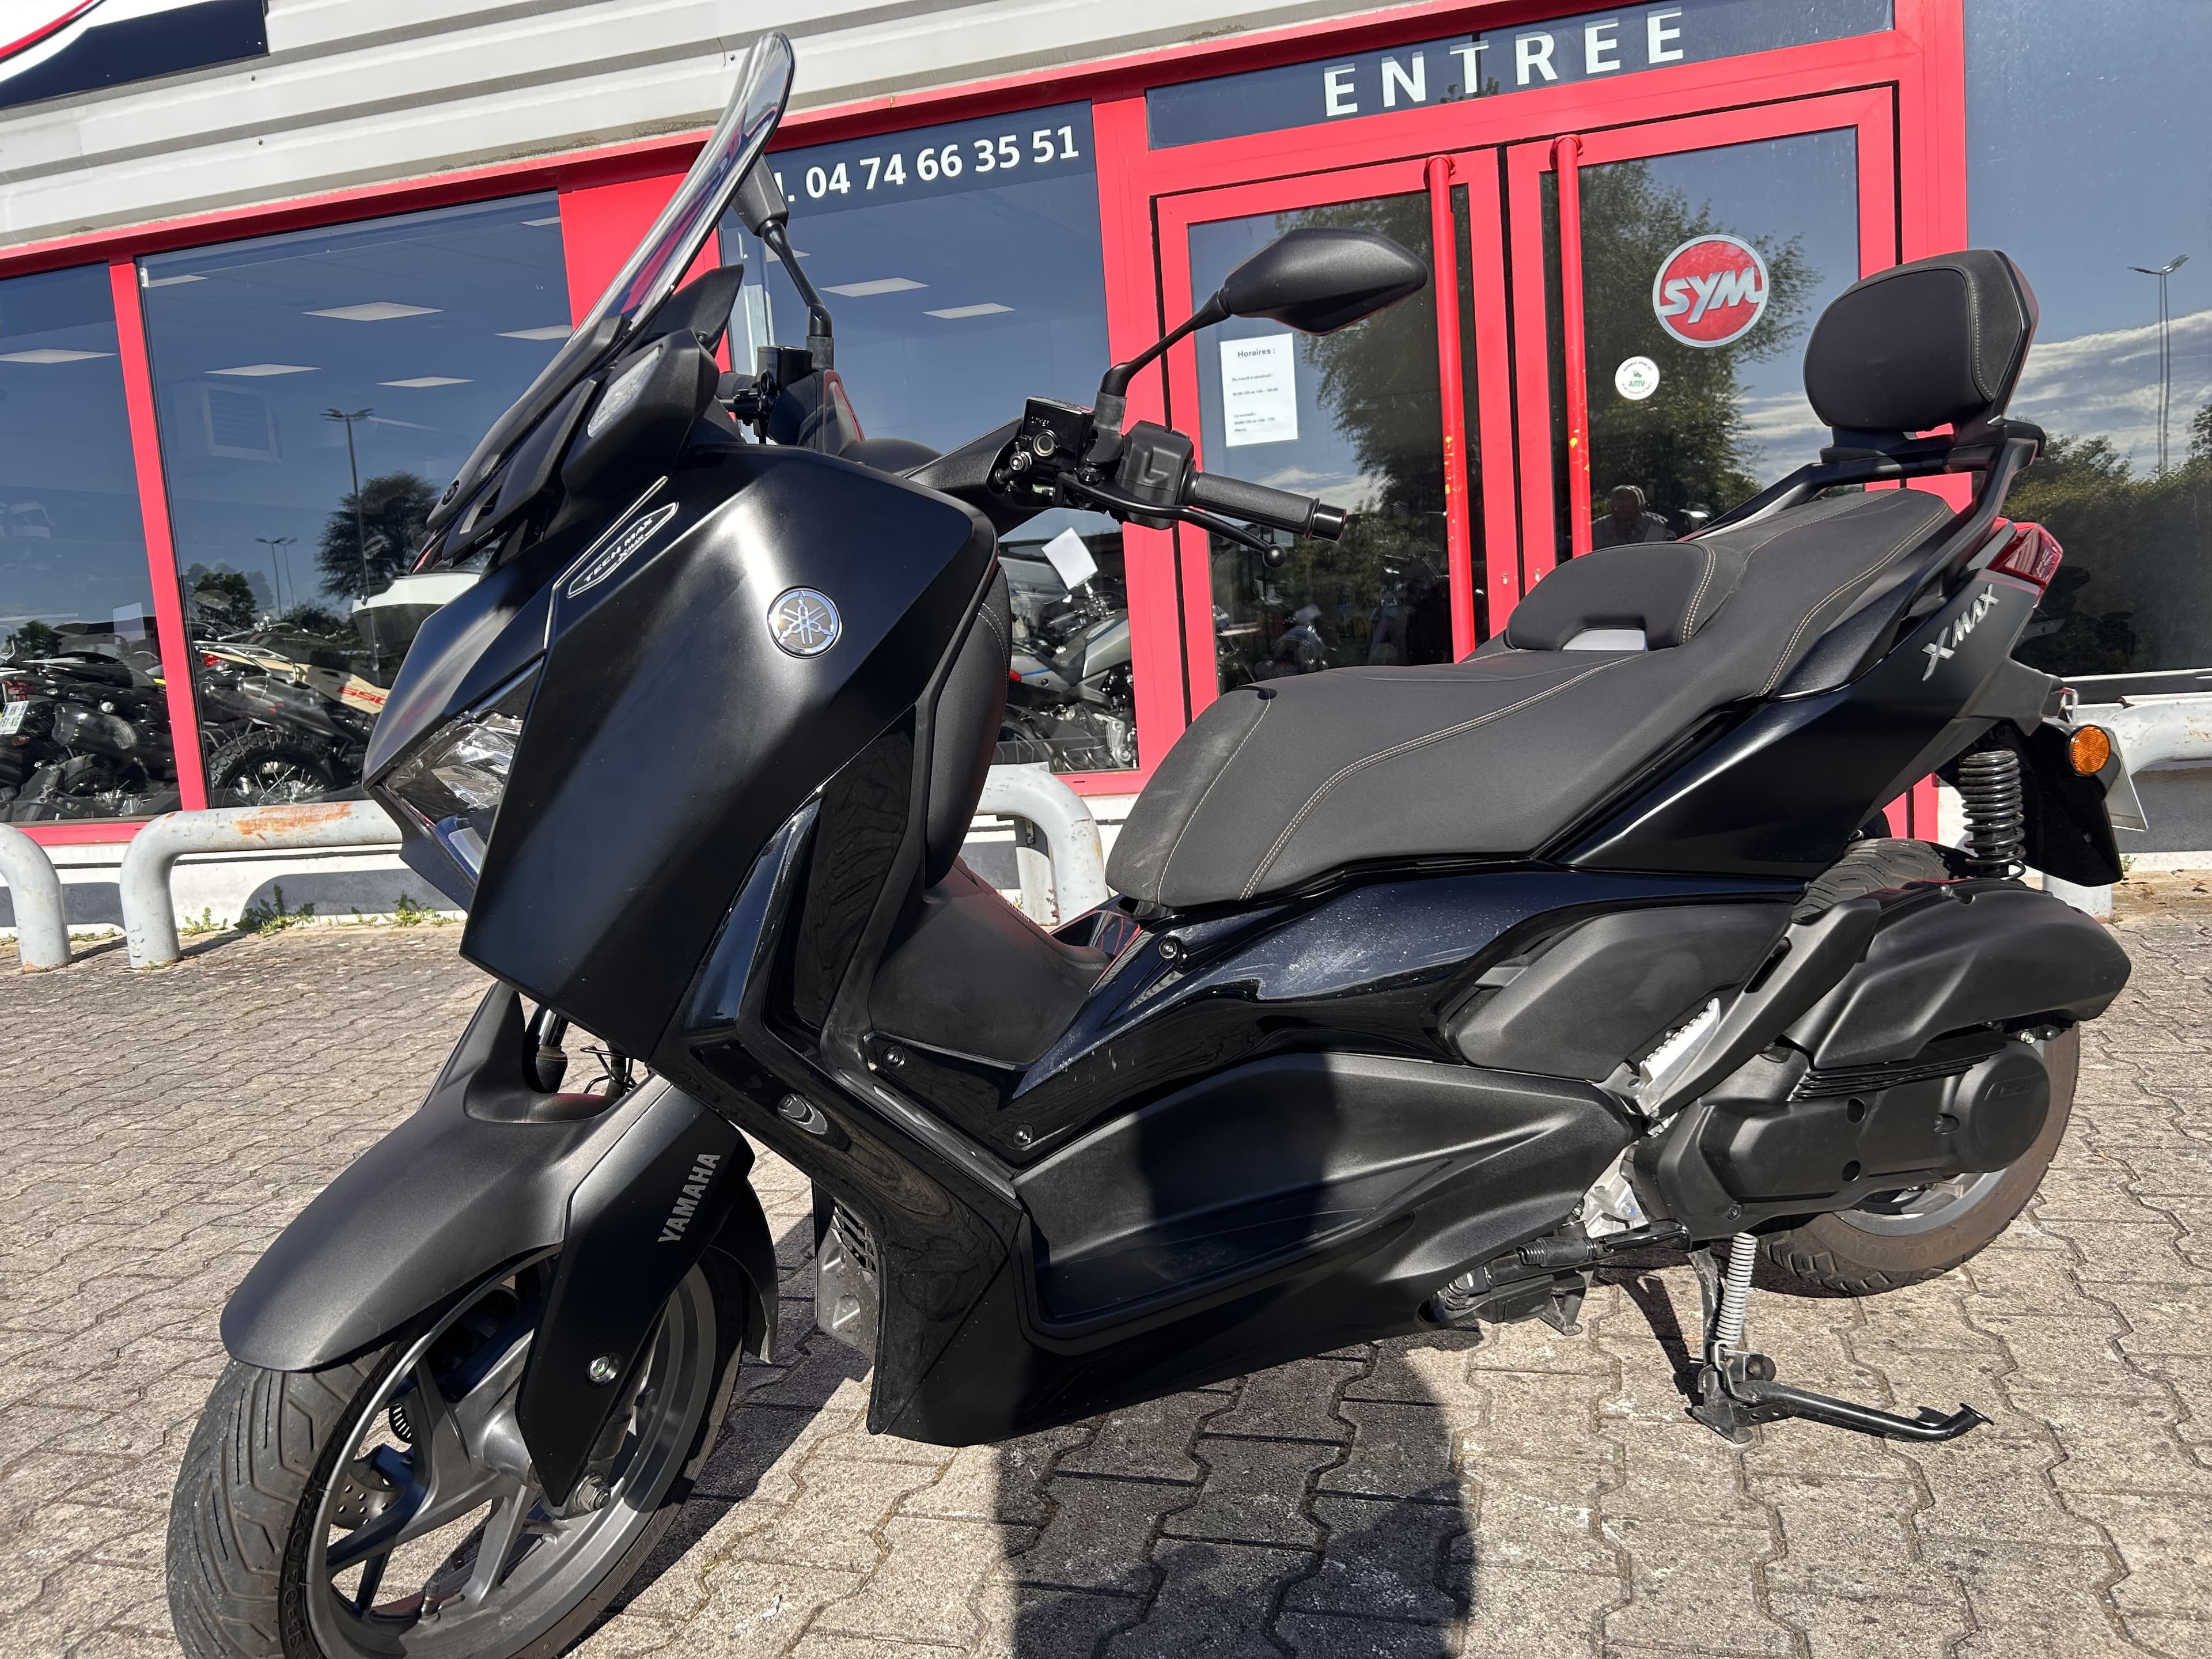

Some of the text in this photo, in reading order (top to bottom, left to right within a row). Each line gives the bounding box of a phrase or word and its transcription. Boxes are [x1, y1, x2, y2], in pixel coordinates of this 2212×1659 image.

[1323, 6, 1684, 117] ENTREE
[806, 162, 851, 199] 04
[859, 153, 907, 190] 74
[916, 145, 963, 181] 66
[974, 135, 1021, 172] 35
[1032, 126, 1079, 163] 51
[1659, 267, 1763, 324] SYM
[1238, 349, 1271, 358] Horaires
[584, 517, 653, 582] TECH MAX
[657, 1154, 721, 1243] YAMAHA
